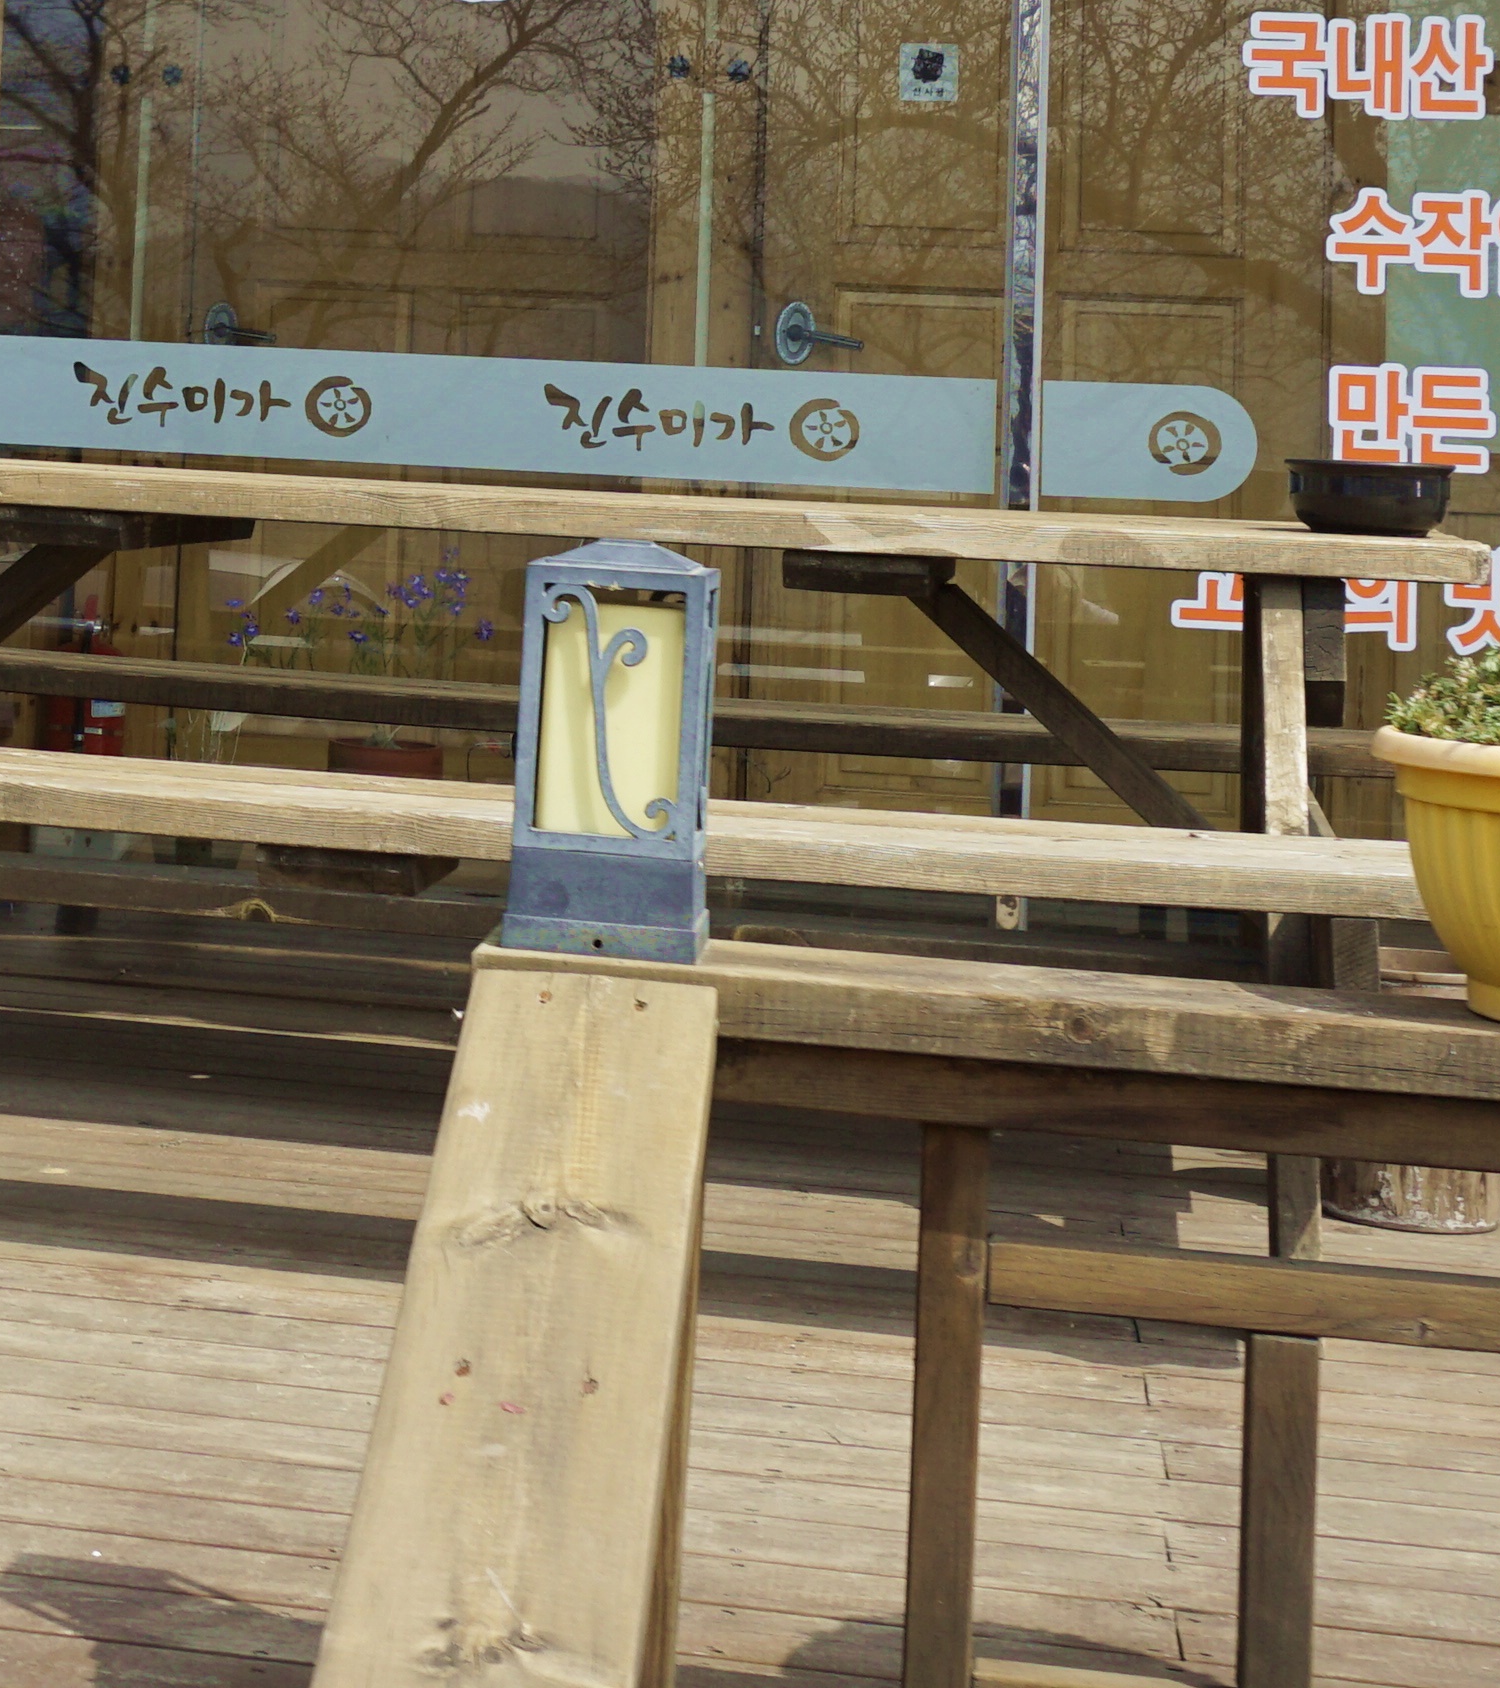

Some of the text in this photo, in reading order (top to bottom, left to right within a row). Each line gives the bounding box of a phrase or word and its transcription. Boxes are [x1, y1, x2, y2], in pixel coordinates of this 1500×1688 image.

[1242, 12, 1493, 122] 국내산
[73, 360, 292, 424] 진수미가
[544, 382, 774, 449] 진수미가
[1329, 363, 1497, 474] 만든
